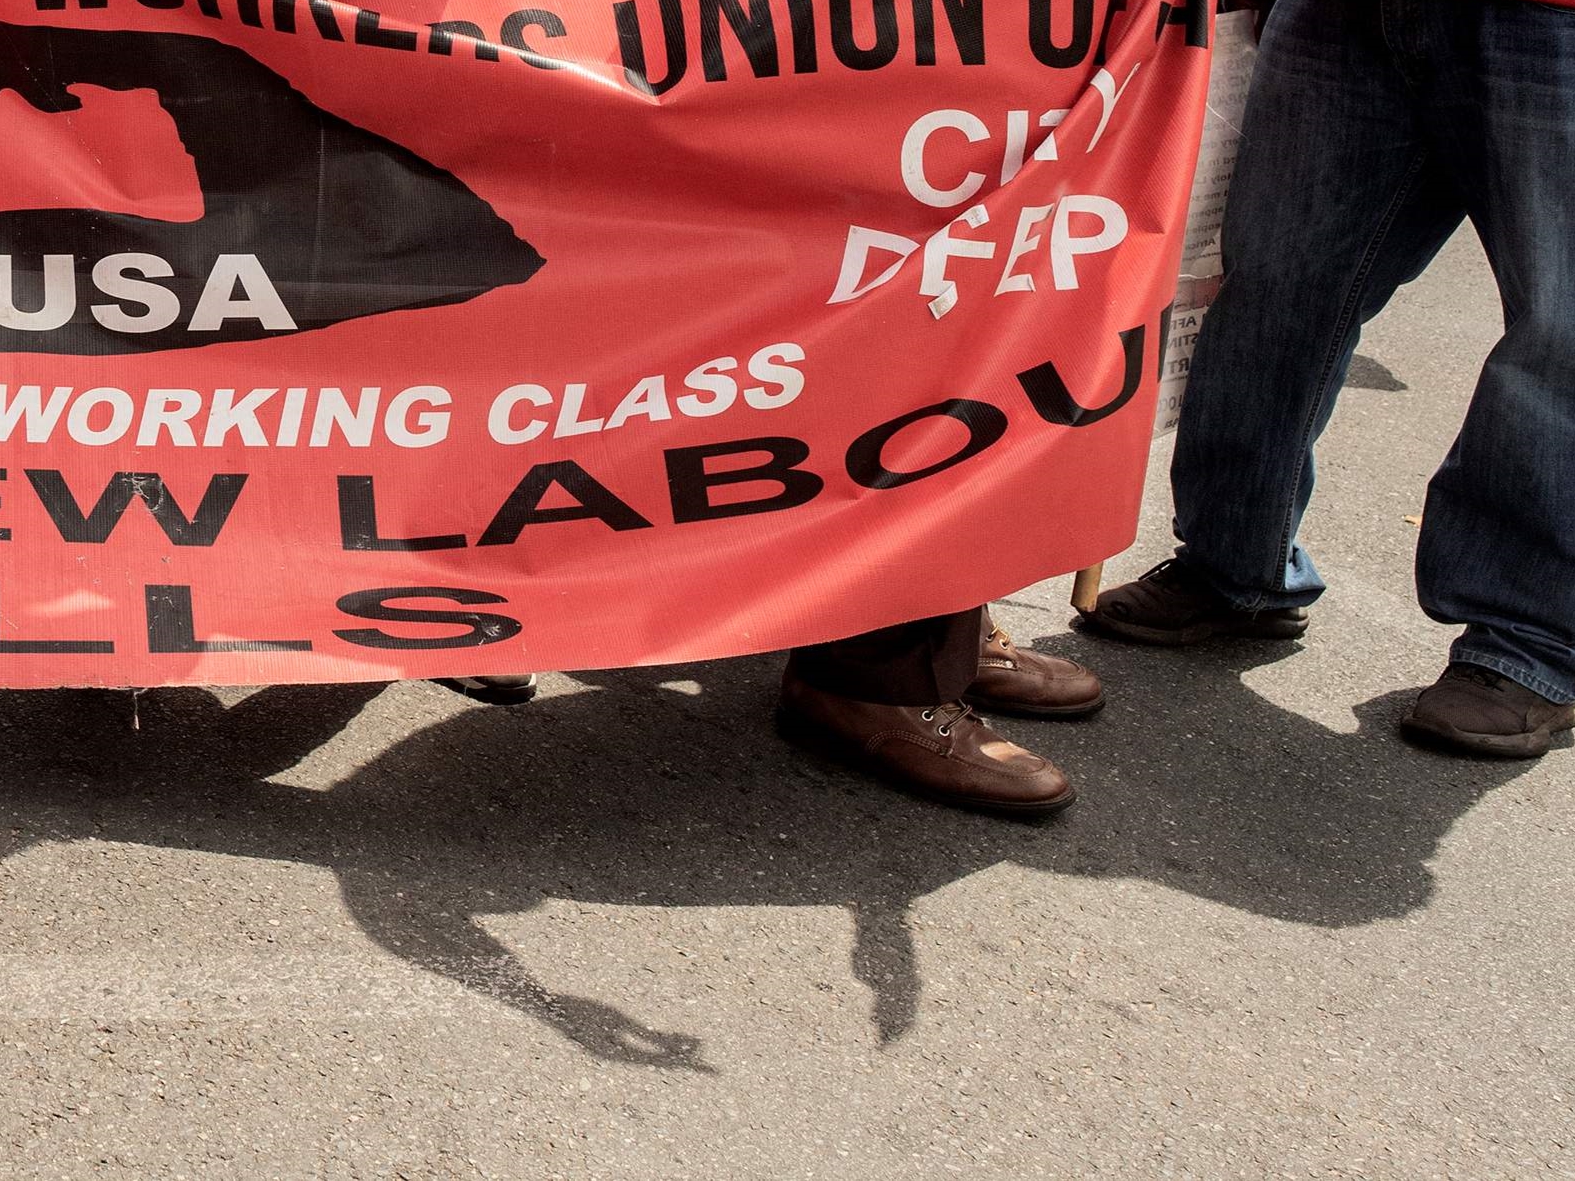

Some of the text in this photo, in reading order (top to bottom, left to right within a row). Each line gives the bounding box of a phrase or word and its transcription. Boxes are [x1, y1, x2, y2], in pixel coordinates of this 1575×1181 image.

[826, 195, 1128, 320] DEEP
[337, 303, 1174, 551] LABOU
[487, 342, 806, 447] CLASS
